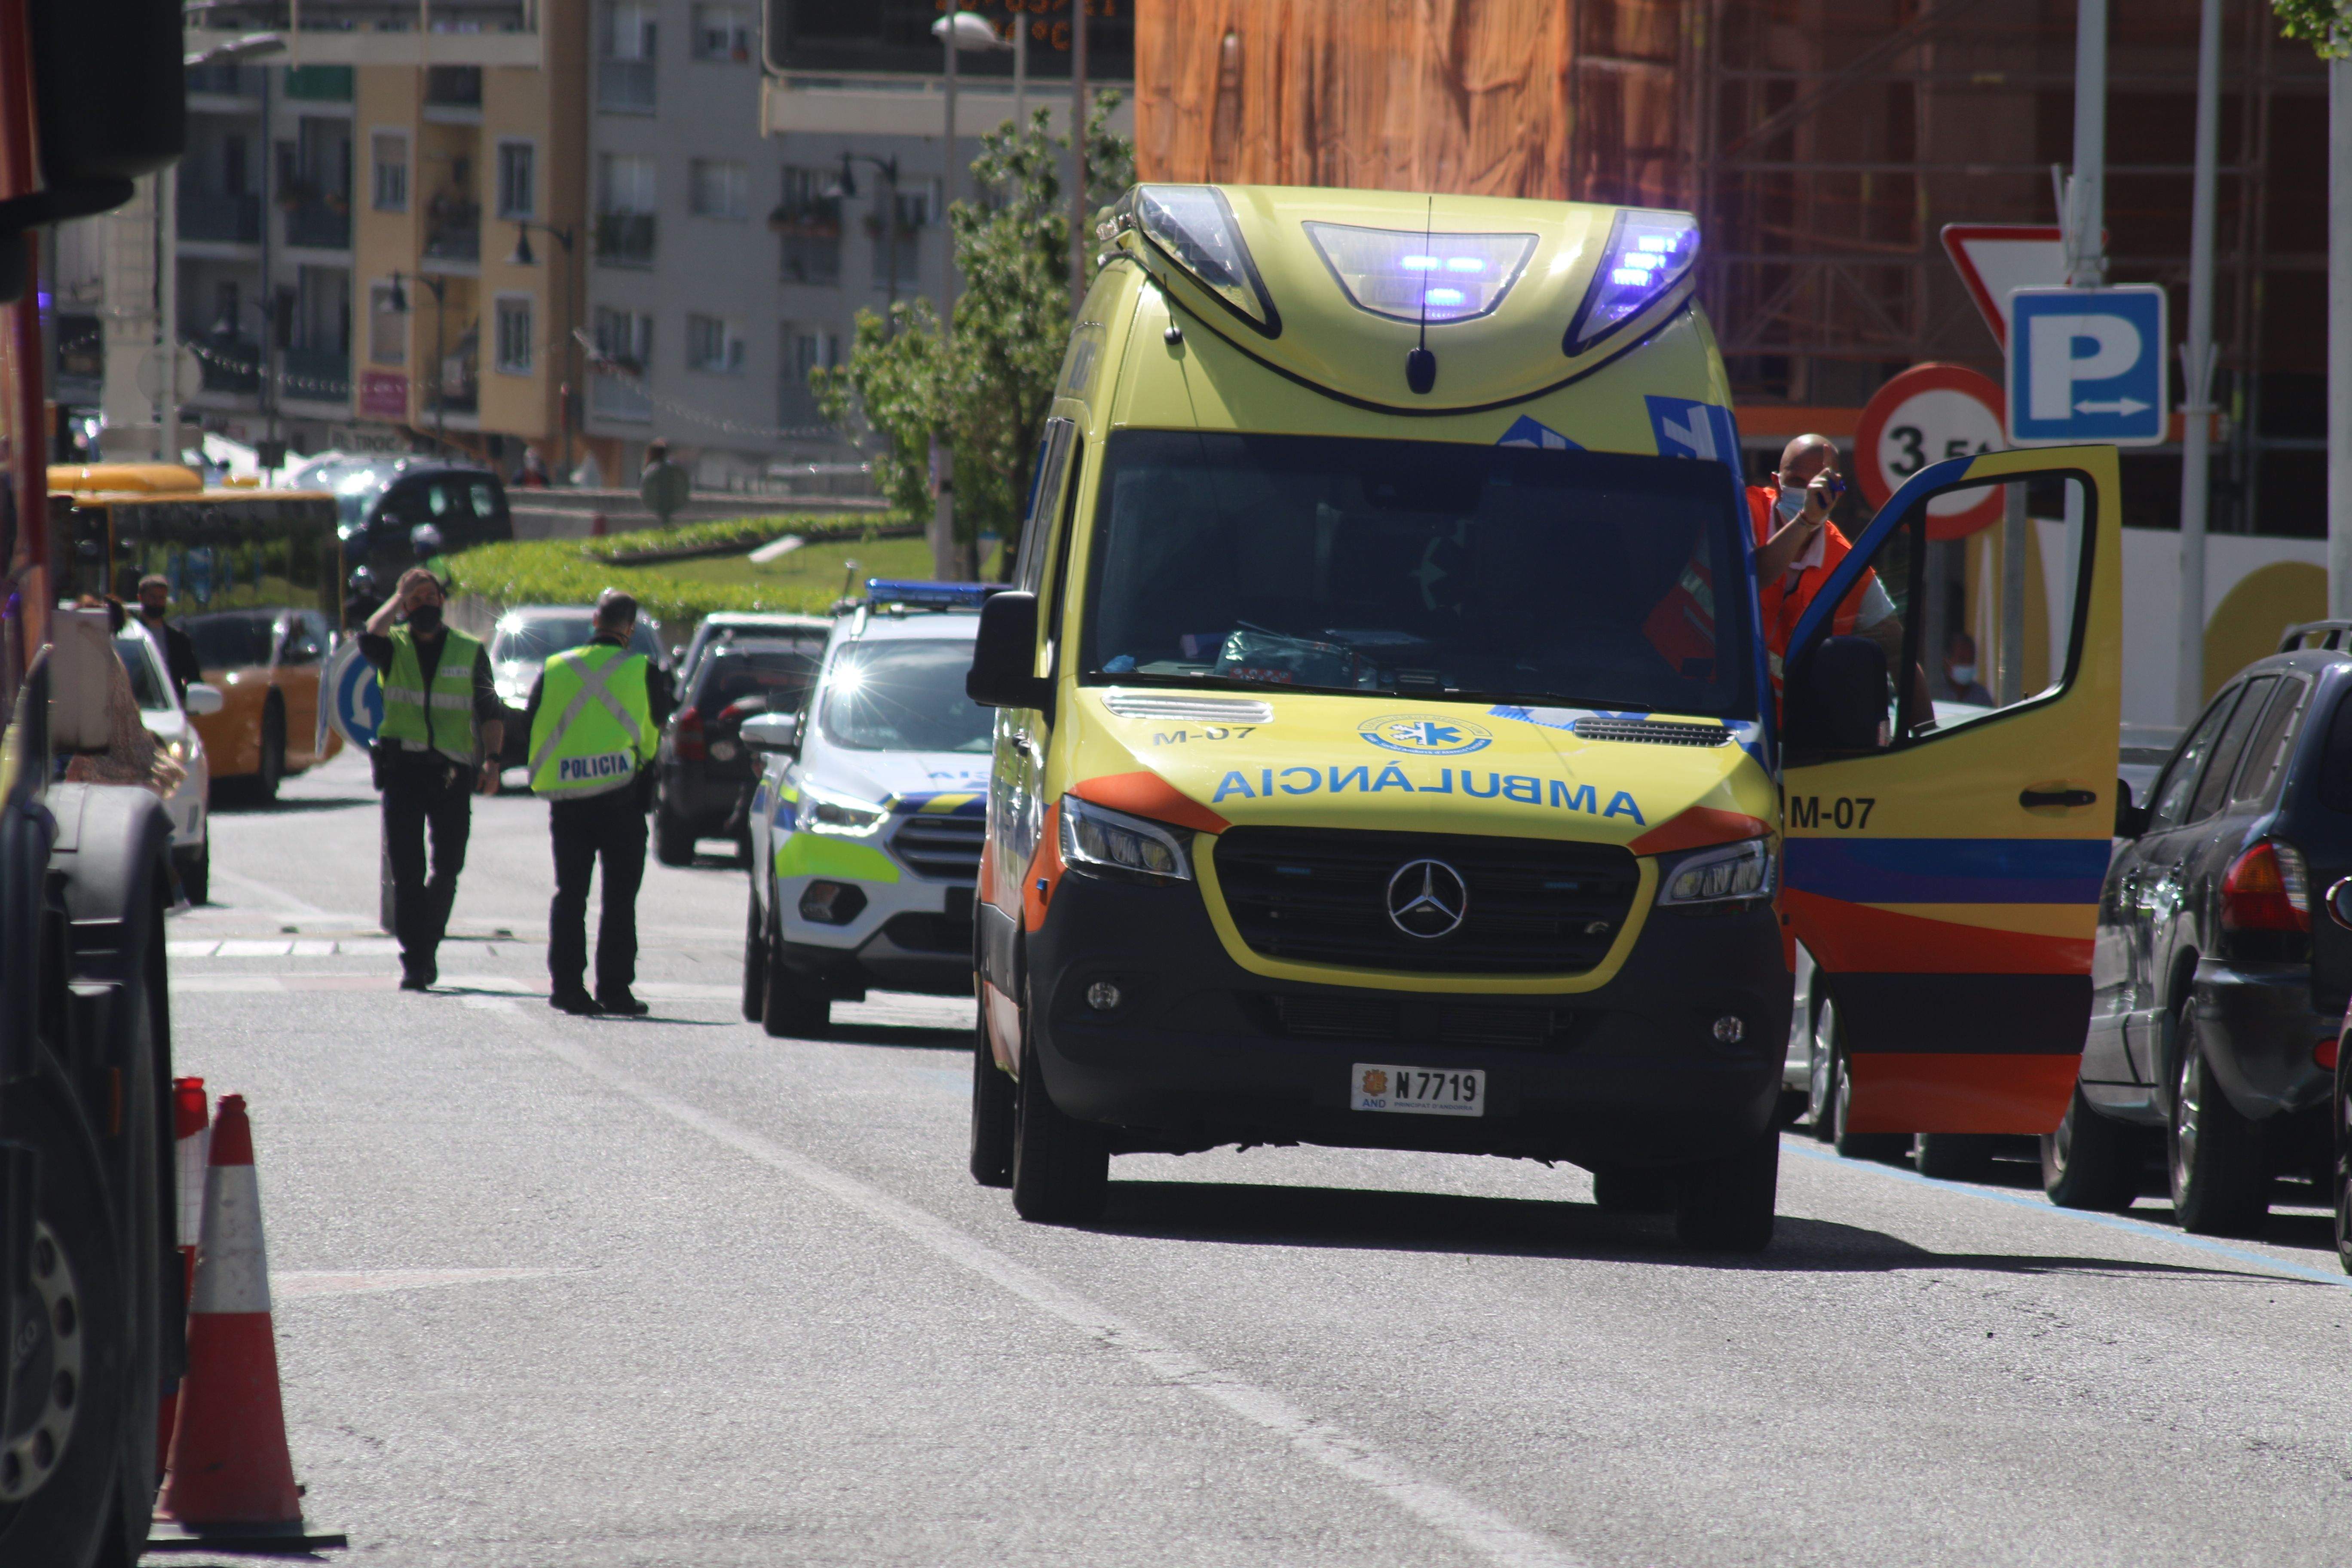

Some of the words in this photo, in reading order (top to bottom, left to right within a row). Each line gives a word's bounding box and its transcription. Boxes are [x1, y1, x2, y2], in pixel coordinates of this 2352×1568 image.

[2029, 315, 2141, 420] P
[1152, 727, 1256, 746] M-07
[560, 754, 629, 779] POLICIA
[1791, 796, 1875, 830] M-07
[1362, 1098, 1386, 1108] AND
